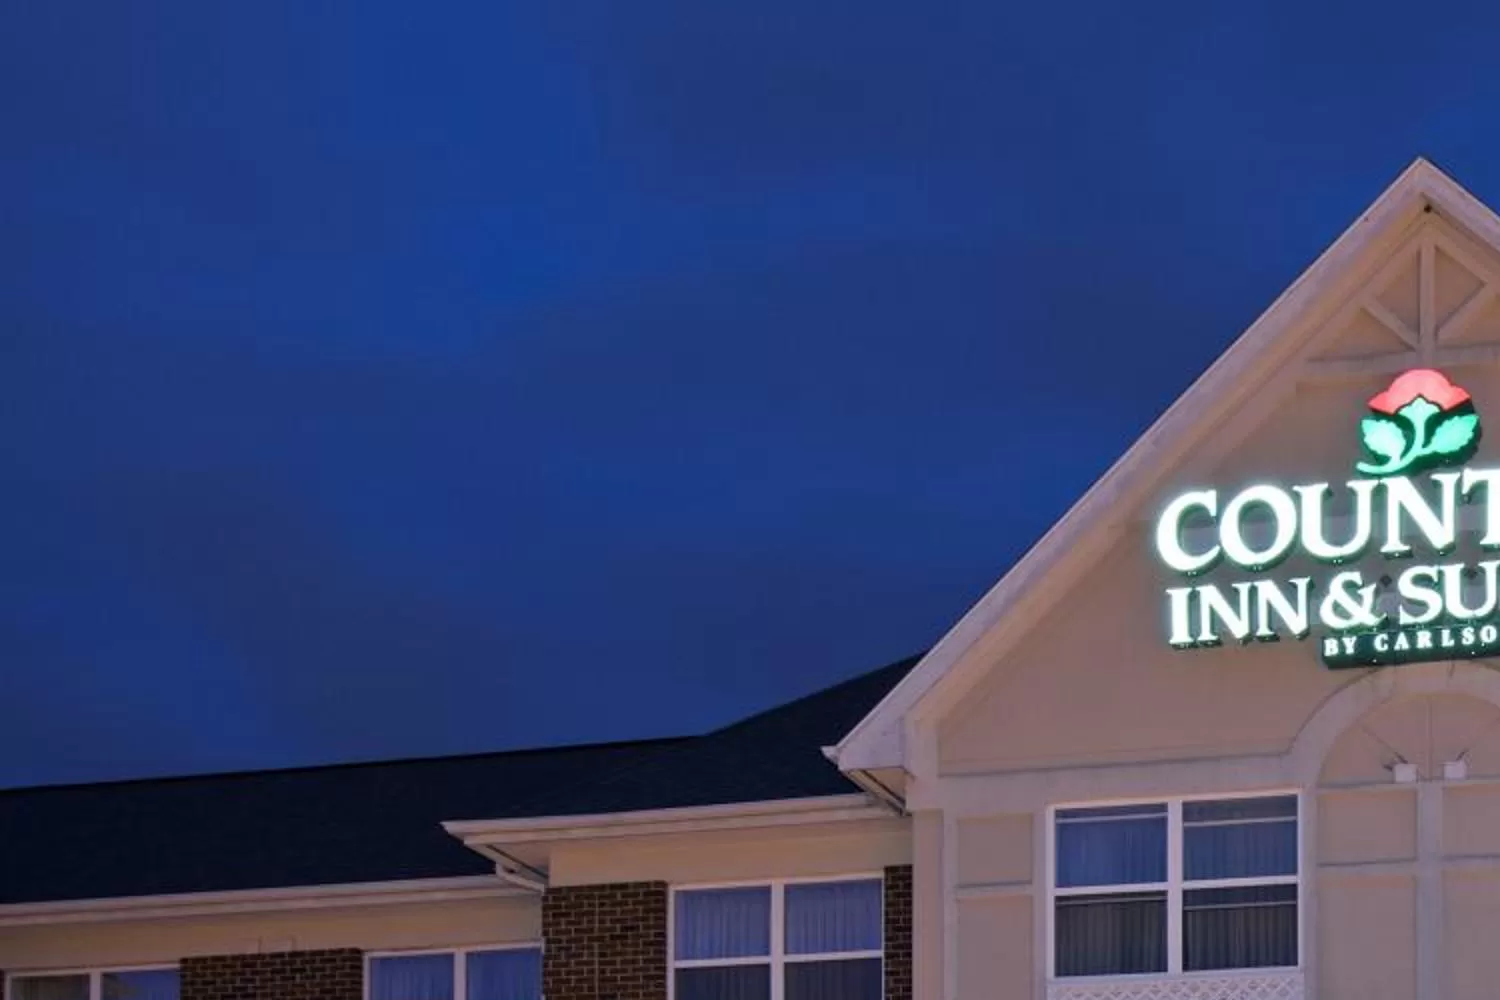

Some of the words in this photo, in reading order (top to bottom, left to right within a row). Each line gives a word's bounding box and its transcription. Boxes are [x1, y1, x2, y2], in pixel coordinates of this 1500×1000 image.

[1166, 577, 1313, 647] INN
[1319, 571, 1388, 631] &
[1323, 636, 1356, 658] BY
